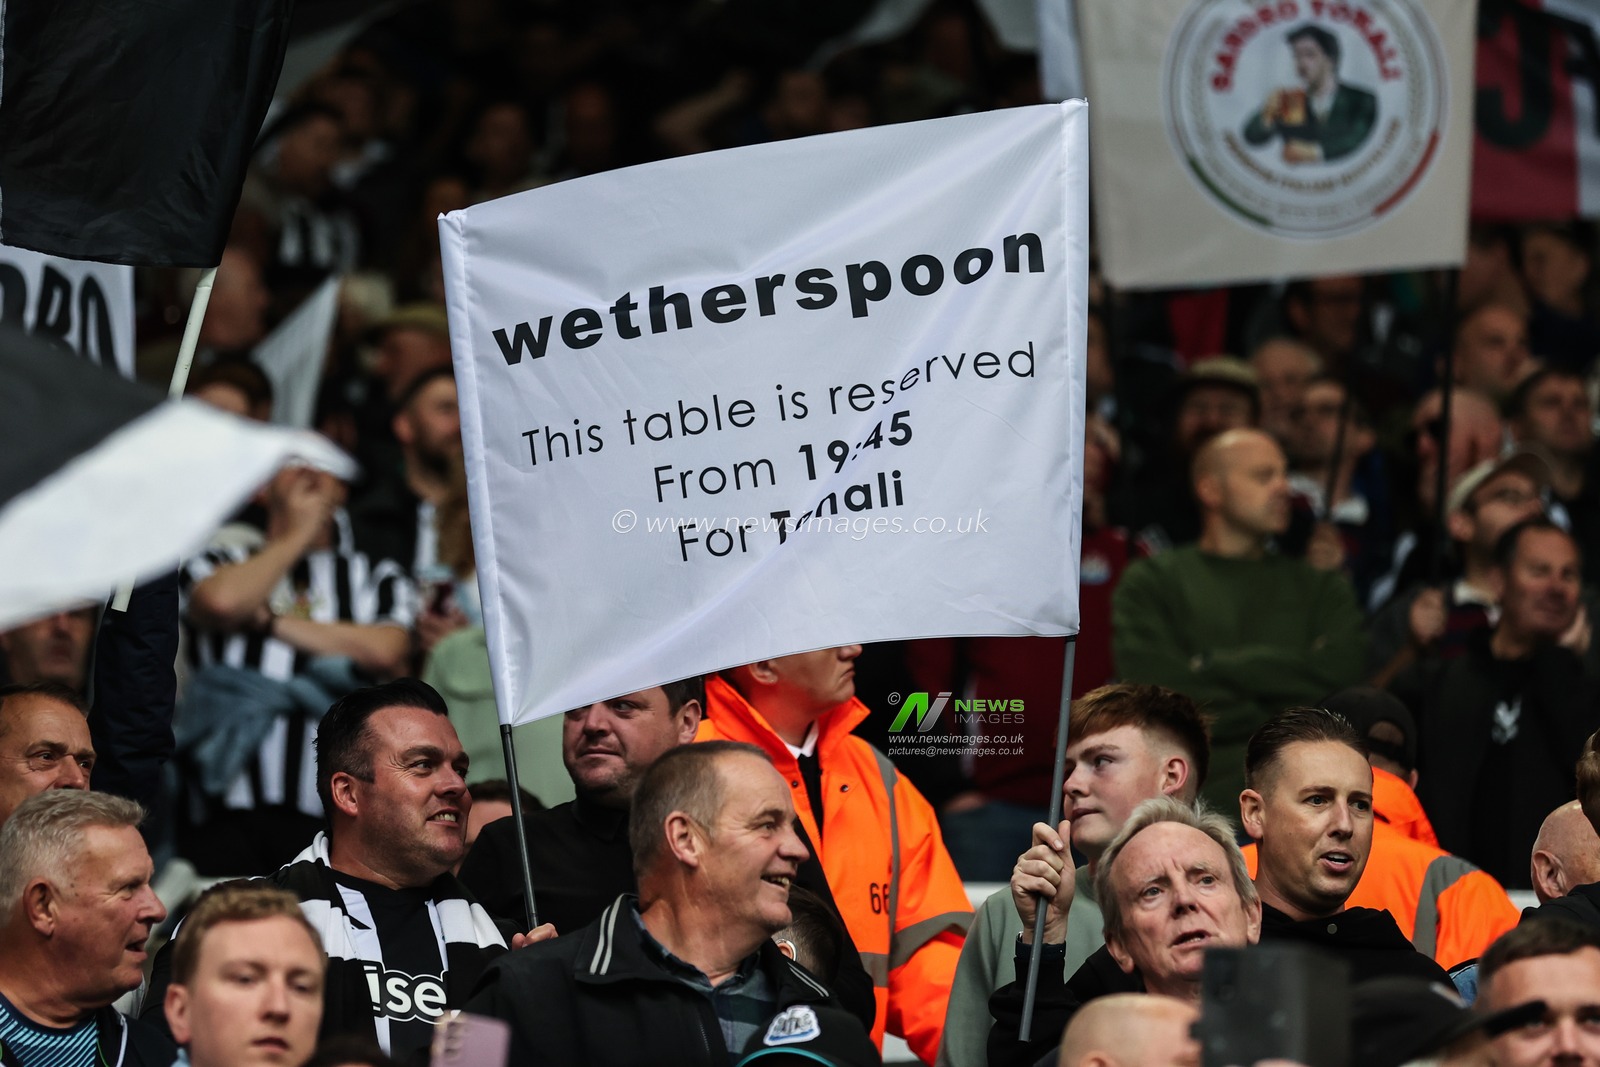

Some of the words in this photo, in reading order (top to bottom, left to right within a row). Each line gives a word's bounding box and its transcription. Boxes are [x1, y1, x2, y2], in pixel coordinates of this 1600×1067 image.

[491, 232, 1045, 366] wetherspoon
[521, 418, 604, 466] This
[622, 394, 756, 446] table
[775, 383, 809, 421] is
[828, 340, 1035, 414] reserved
[653, 458, 776, 503] From
[798, 409, 913, 481] 19:45
[678, 523, 753, 562] For
